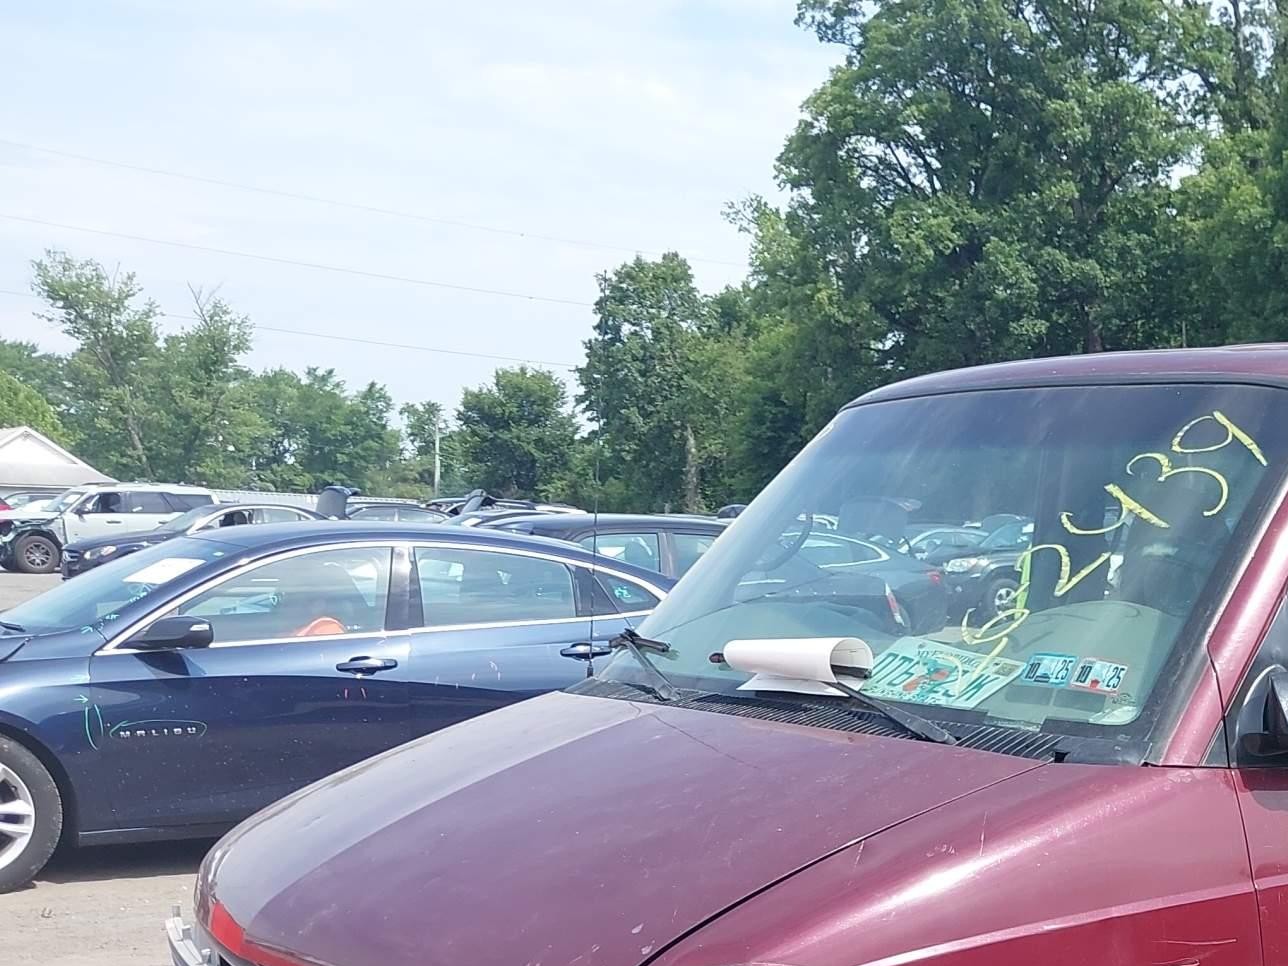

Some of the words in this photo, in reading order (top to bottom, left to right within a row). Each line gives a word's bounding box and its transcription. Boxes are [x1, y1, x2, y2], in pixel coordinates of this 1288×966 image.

[1025, 662, 1041, 680] 10
[1055, 659, 1074, 680] 25
[1076, 664, 1093, 684] 10
[1106, 666, 1125, 689] 25
[119, 726, 197, 738] MALIBU
